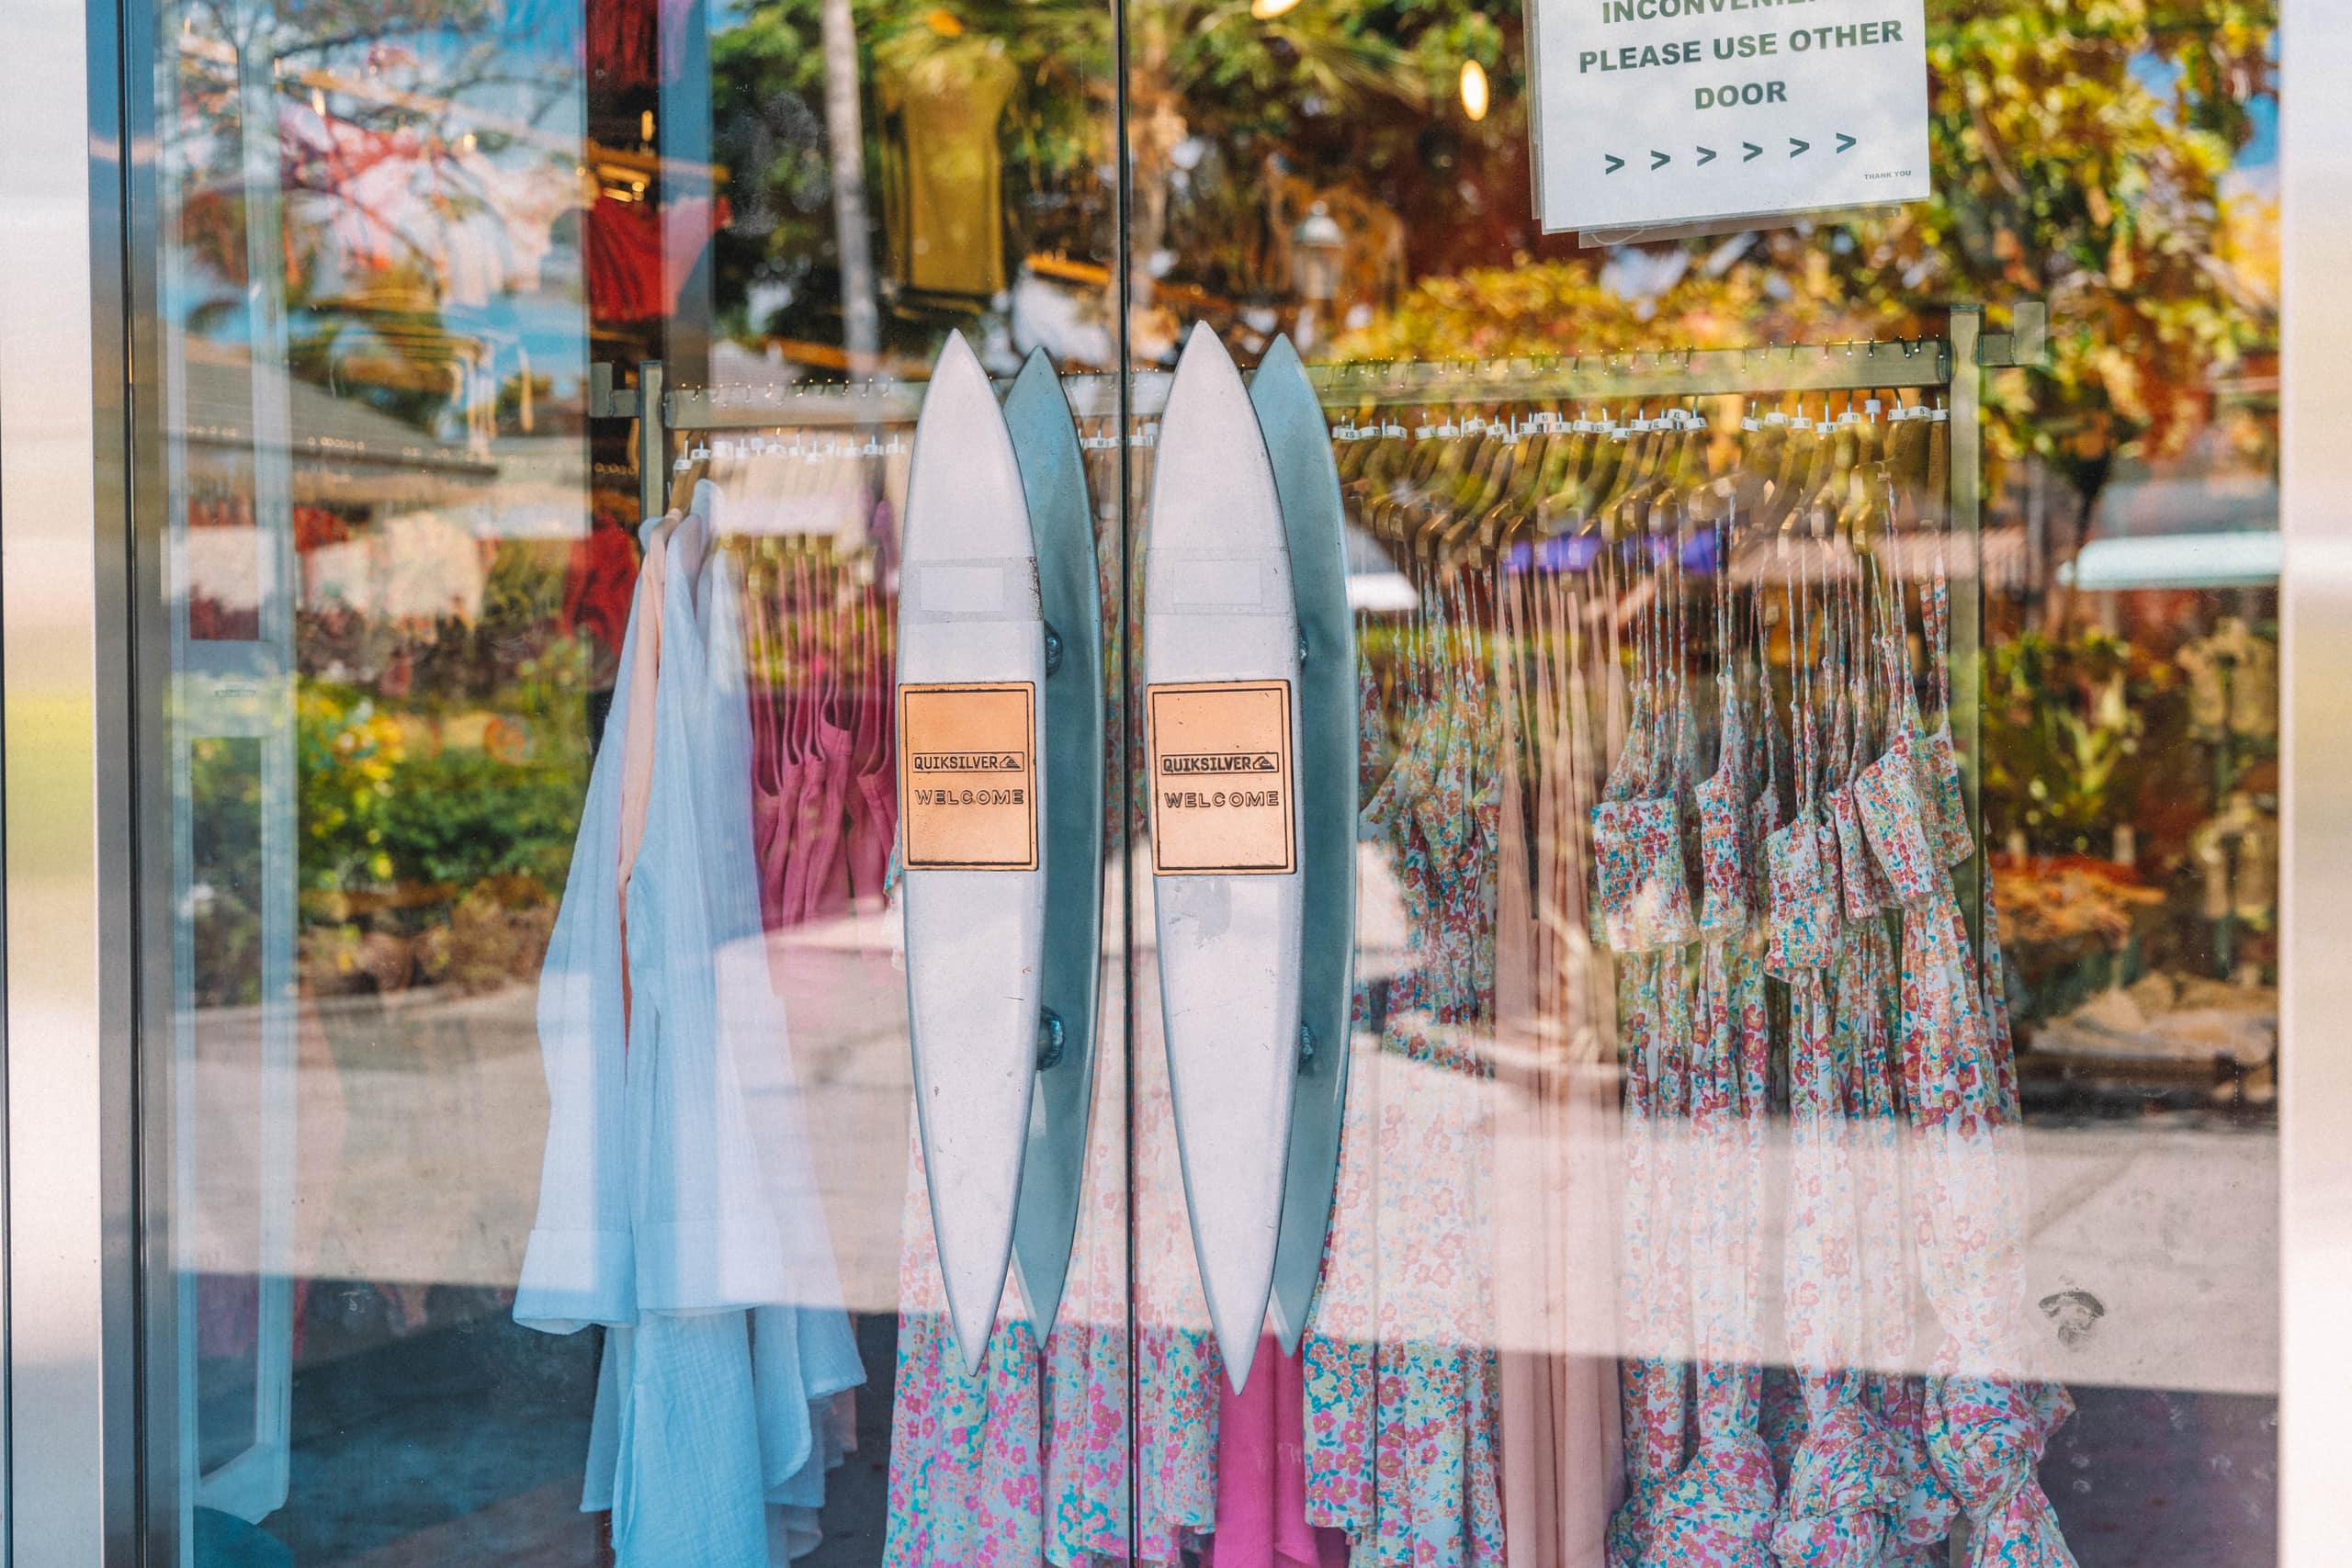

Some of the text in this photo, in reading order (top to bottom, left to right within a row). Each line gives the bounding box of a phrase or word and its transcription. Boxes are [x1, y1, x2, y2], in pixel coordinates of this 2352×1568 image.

[1602, 0, 1807, 24] INCONV
[1579, 20, 1904, 73] PLEASE USE OTHER
[1694, 81, 1787, 110] DOOR
[1864, 171, 1893, 180] THANK
[914, 756, 998, 770] QUIKSILVER
[1163, 756, 1251, 773] QUIKSILVER
[914, 789, 1023, 805] WELCOME
[1163, 791, 1280, 807] WELCOME
